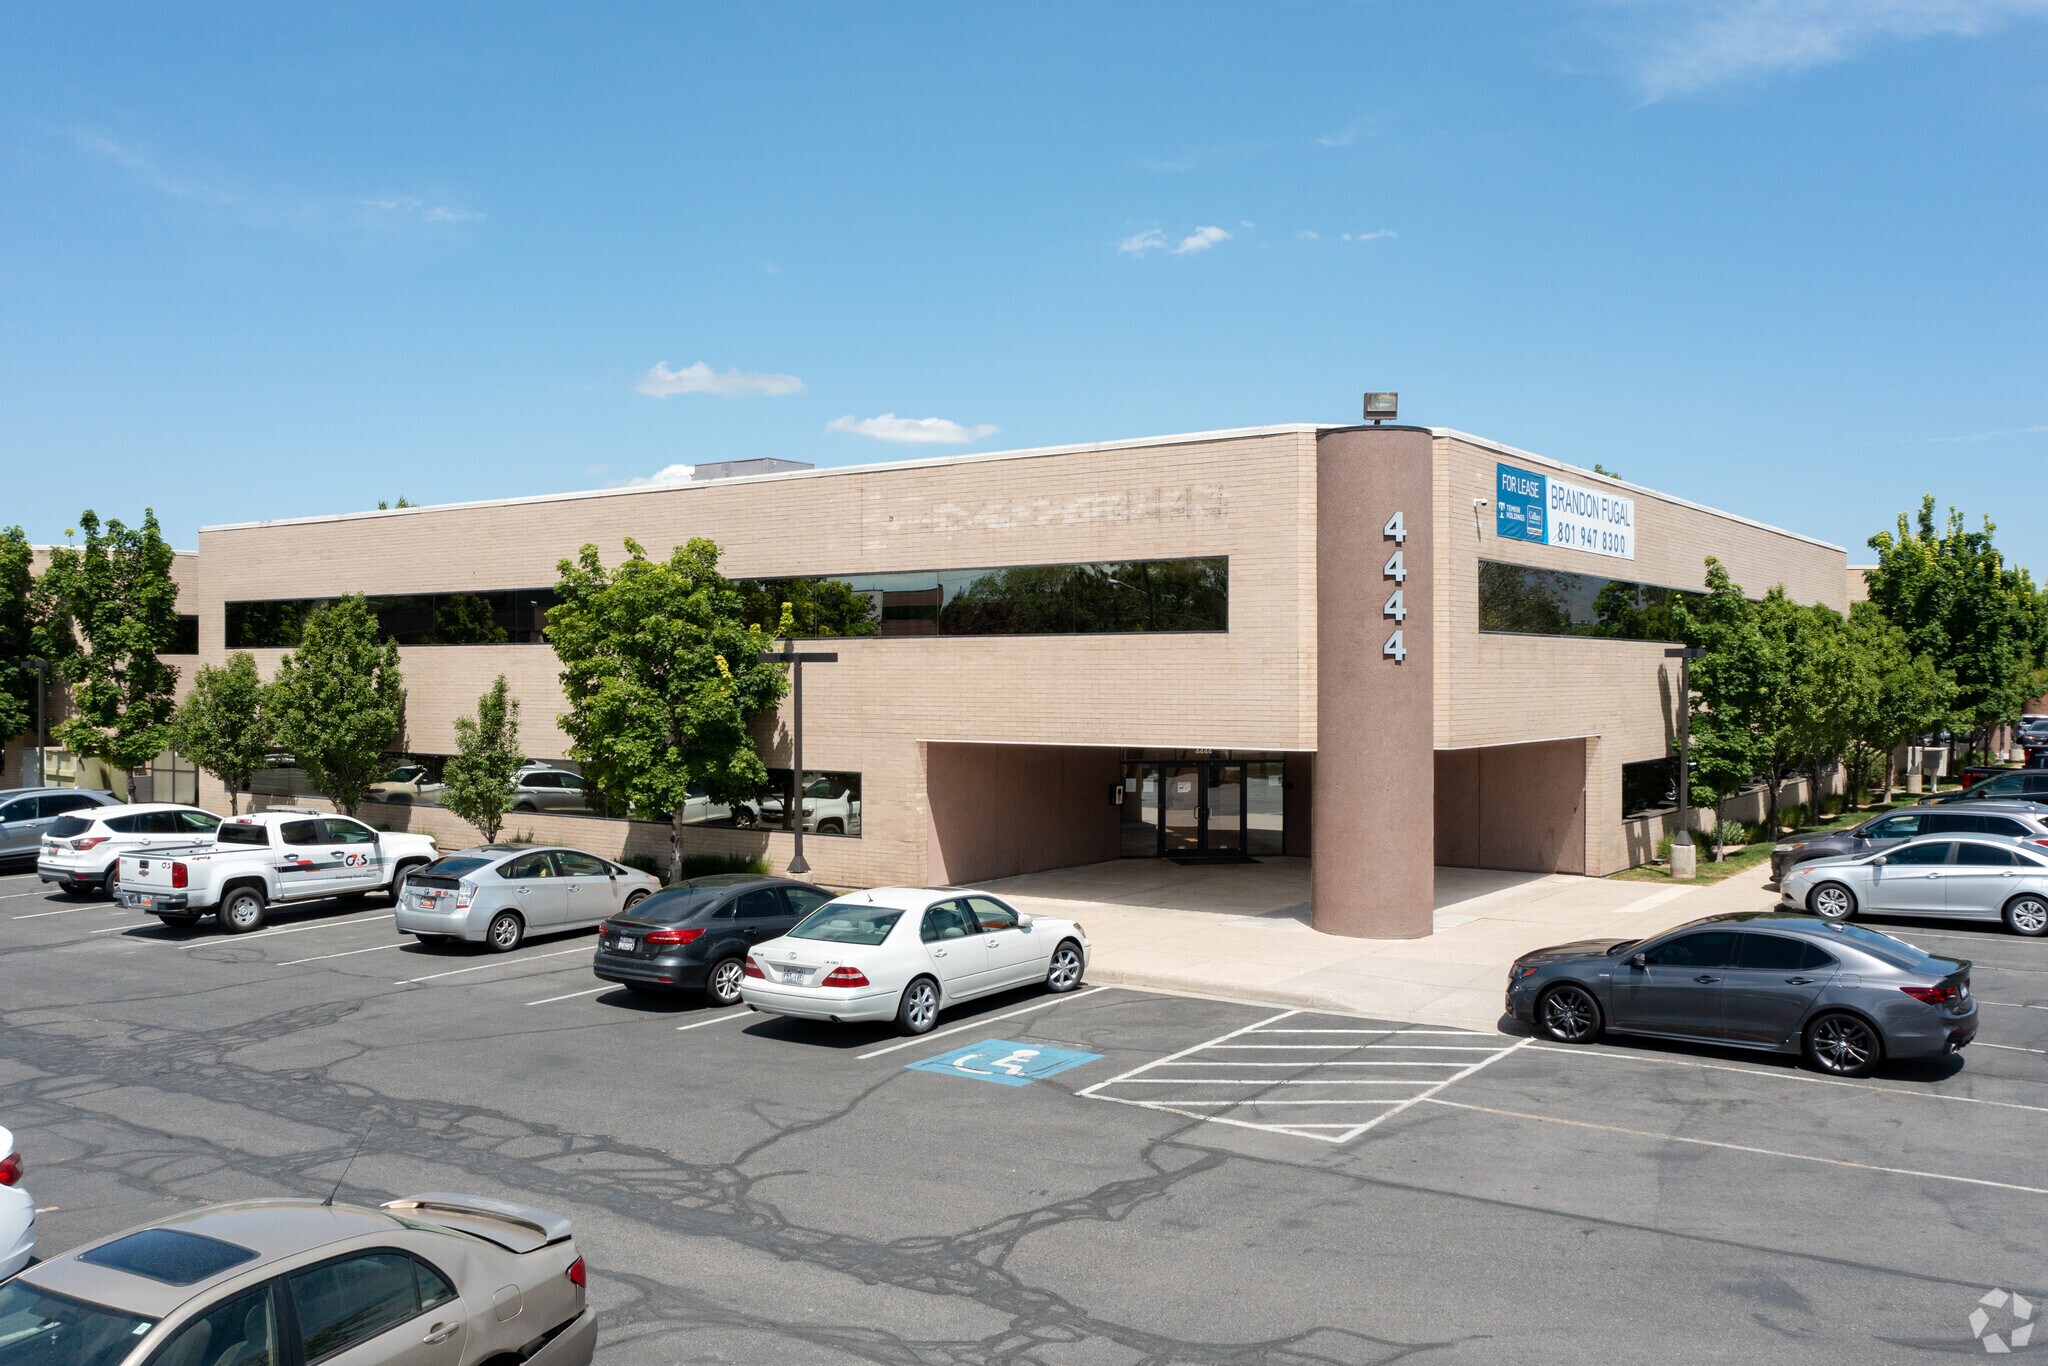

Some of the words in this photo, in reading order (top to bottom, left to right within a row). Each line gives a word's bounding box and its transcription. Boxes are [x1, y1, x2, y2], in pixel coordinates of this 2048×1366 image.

[1502, 474, 1516, 493] FOR
[1517, 478, 1539, 498] LEASE
[1506, 511, 1525, 521] HOLDINGS
[1551, 484, 1599, 519] BRANDON
[1602, 497, 1630, 527] FUGAL
[1557, 521, 1575, 545] 801
[1581, 526, 1598, 549] 947
[1602, 531, 1625, 553] 8300
